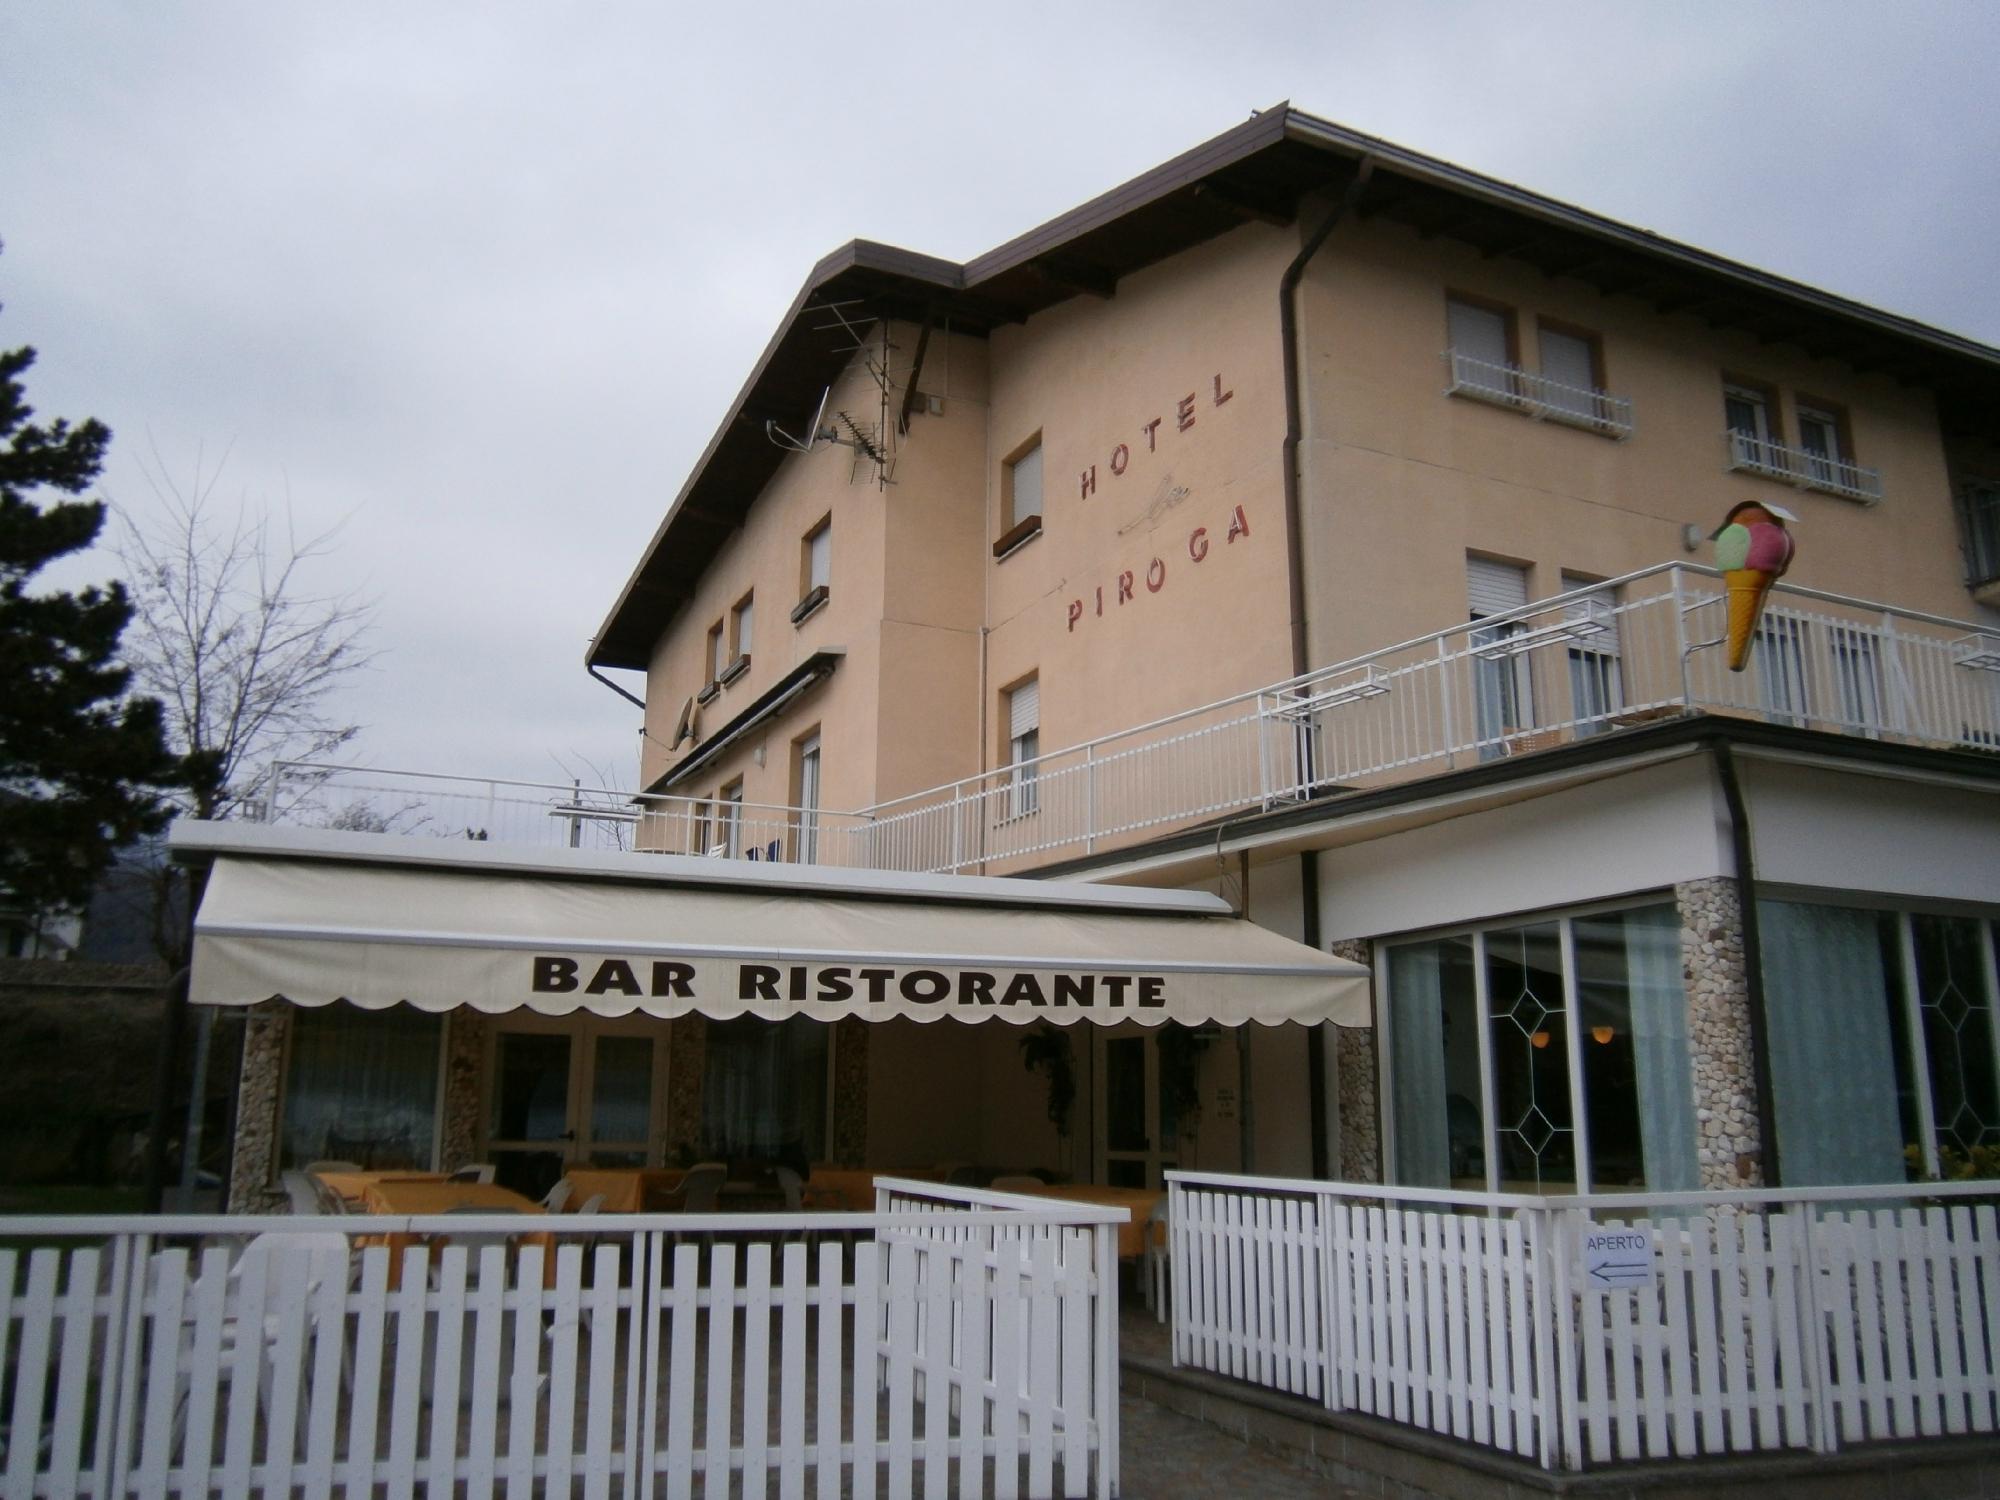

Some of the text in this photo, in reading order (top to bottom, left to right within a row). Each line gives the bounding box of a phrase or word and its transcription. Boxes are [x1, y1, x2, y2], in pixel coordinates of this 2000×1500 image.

[1080, 373, 1234, 500] HOTEL
[1067, 504, 1249, 633] PIROGA
[532, 956, 1166, 1008] BAR RISTORANTE
[1587, 1235, 1646, 1251] APERTO
